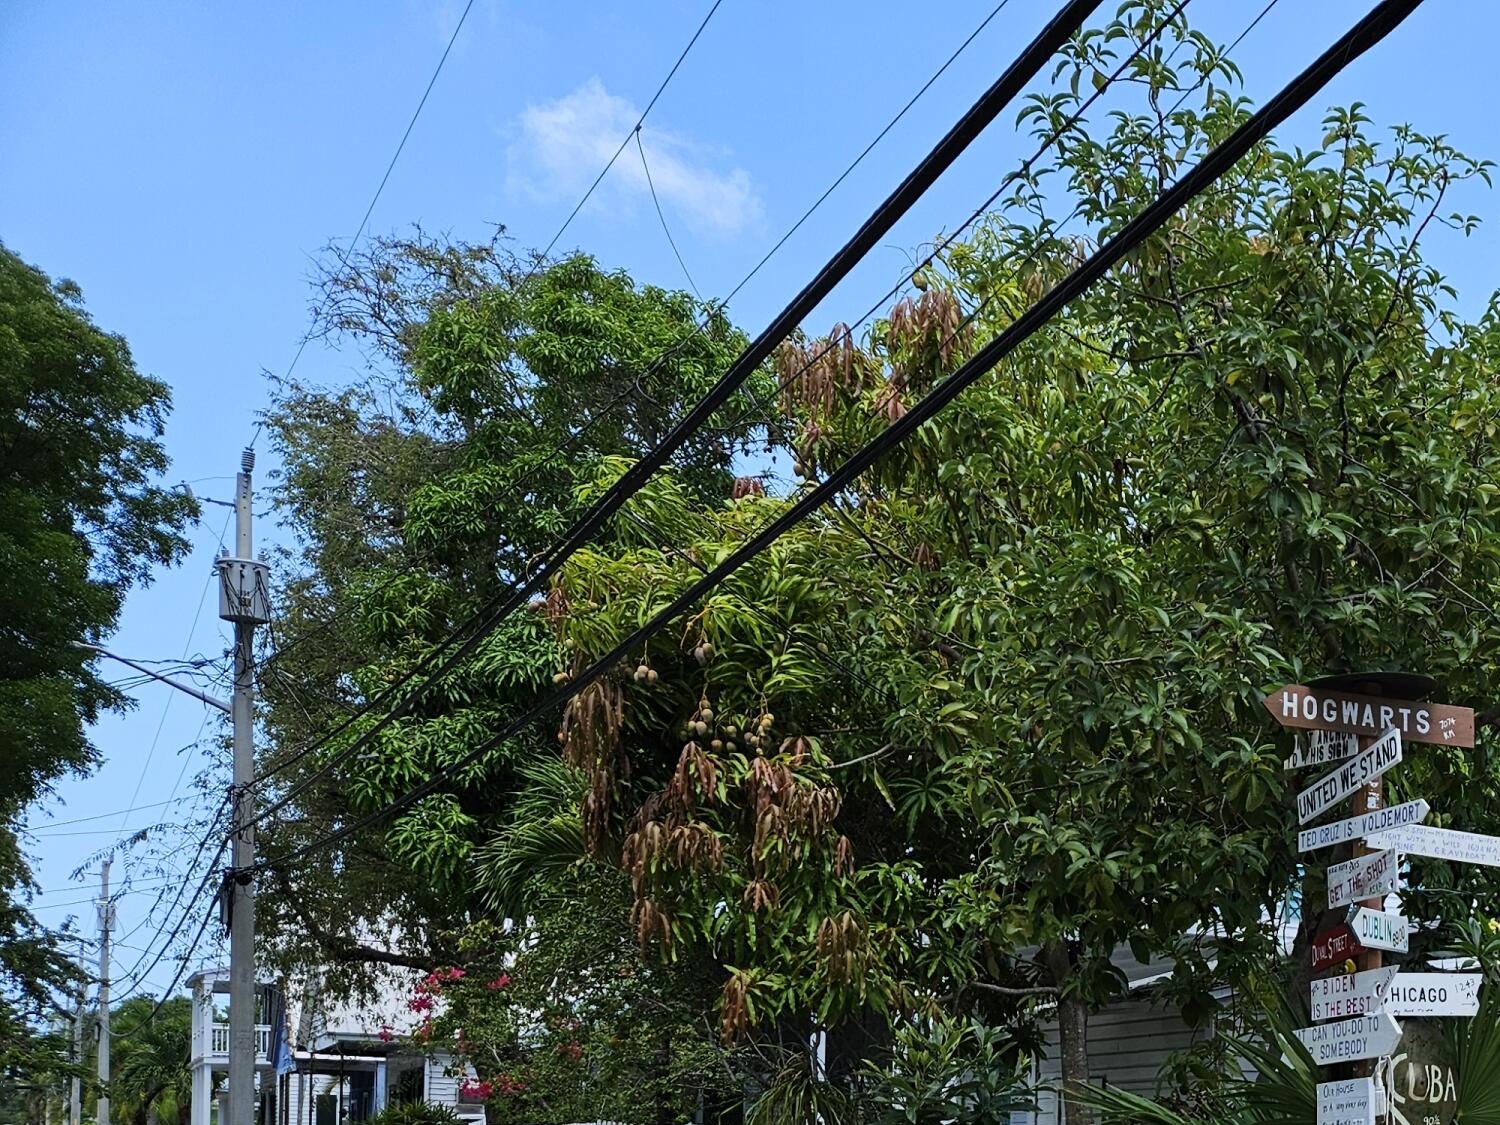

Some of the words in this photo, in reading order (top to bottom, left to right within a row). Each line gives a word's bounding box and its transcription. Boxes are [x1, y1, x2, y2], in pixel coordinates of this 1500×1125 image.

[1282, 691, 1431, 734] HOGWARTS
[1443, 729, 1456, 740] KM
[1304, 745, 1325, 765] HIS
[1328, 740, 1349, 760] SIGN
[1299, 780, 1338, 819] UNITED
[1340, 767, 1356, 792] WE
[1361, 736, 1398, 779] STAND
[1300, 831, 1317, 848] TED
[1320, 825, 1340, 843] CRUZ
[1343, 822, 1353, 838] IS
[1361, 803, 1421, 833] VOLDEMORT
[1329, 883, 1344, 904] GET
[1347, 872, 1364, 895] THE
[1366, 854, 1388, 882] SHOT
[1362, 914, 1392, 942] DUBLIN
[1327, 933, 1348, 960] STREET
[1323, 974, 1356, 995] BIDEN
[1386, 987, 1448, 1003] HICAGO
[1312, 1003, 1321, 1019] IS
[1325, 1000, 1342, 1017] THE
[1346, 996, 1371, 1014] BEST
[1312, 1027, 1328, 1042] CAN
[1332, 1022, 1348, 1038] YOU
[1351, 1018, 1363, 1035] DO
[1368, 1016, 1380, 1032] TO
[1320, 1037, 1368, 1060] SOMEBODY
[1386, 1053, 1457, 1104] CUBA
